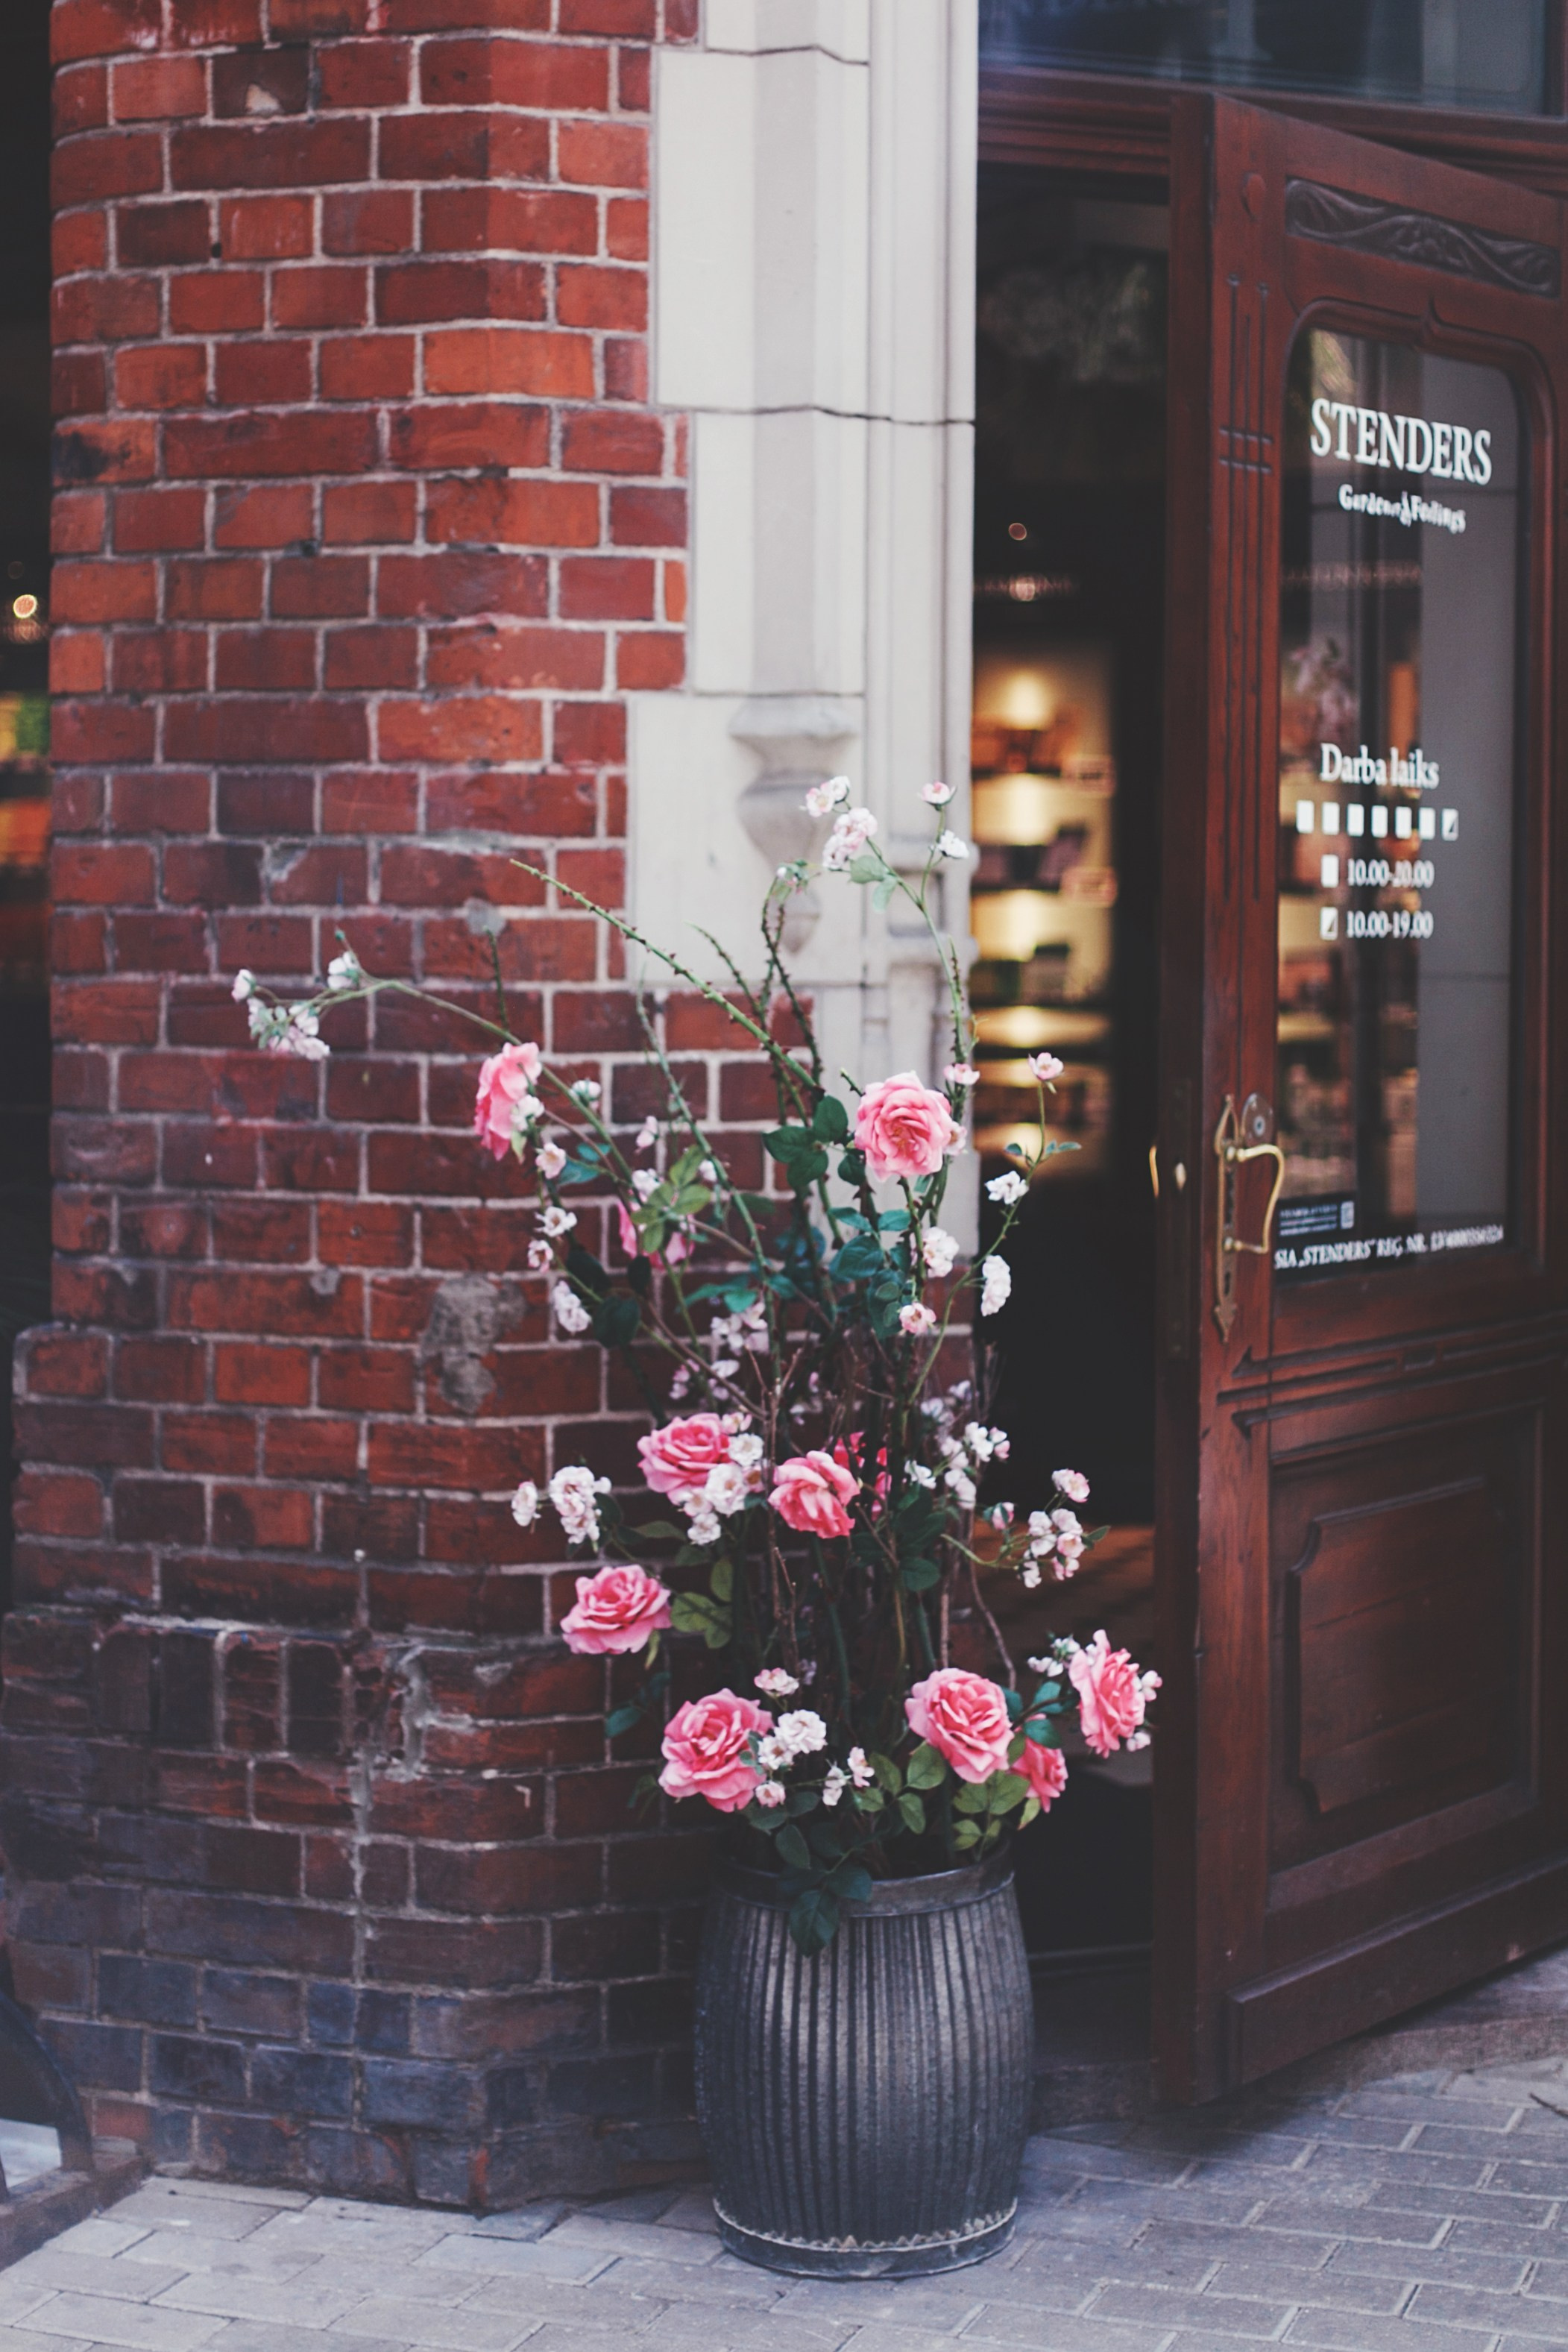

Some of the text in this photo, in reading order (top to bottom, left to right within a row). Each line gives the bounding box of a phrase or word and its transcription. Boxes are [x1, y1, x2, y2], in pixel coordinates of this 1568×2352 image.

[1310, 397, 1492, 485] STENDERS
[1320, 742, 1440, 789] Darba laiks
[1347, 858, 1435, 888] 10.00-20.00
[1347, 910, 1434, 940] 10.00-19.00
